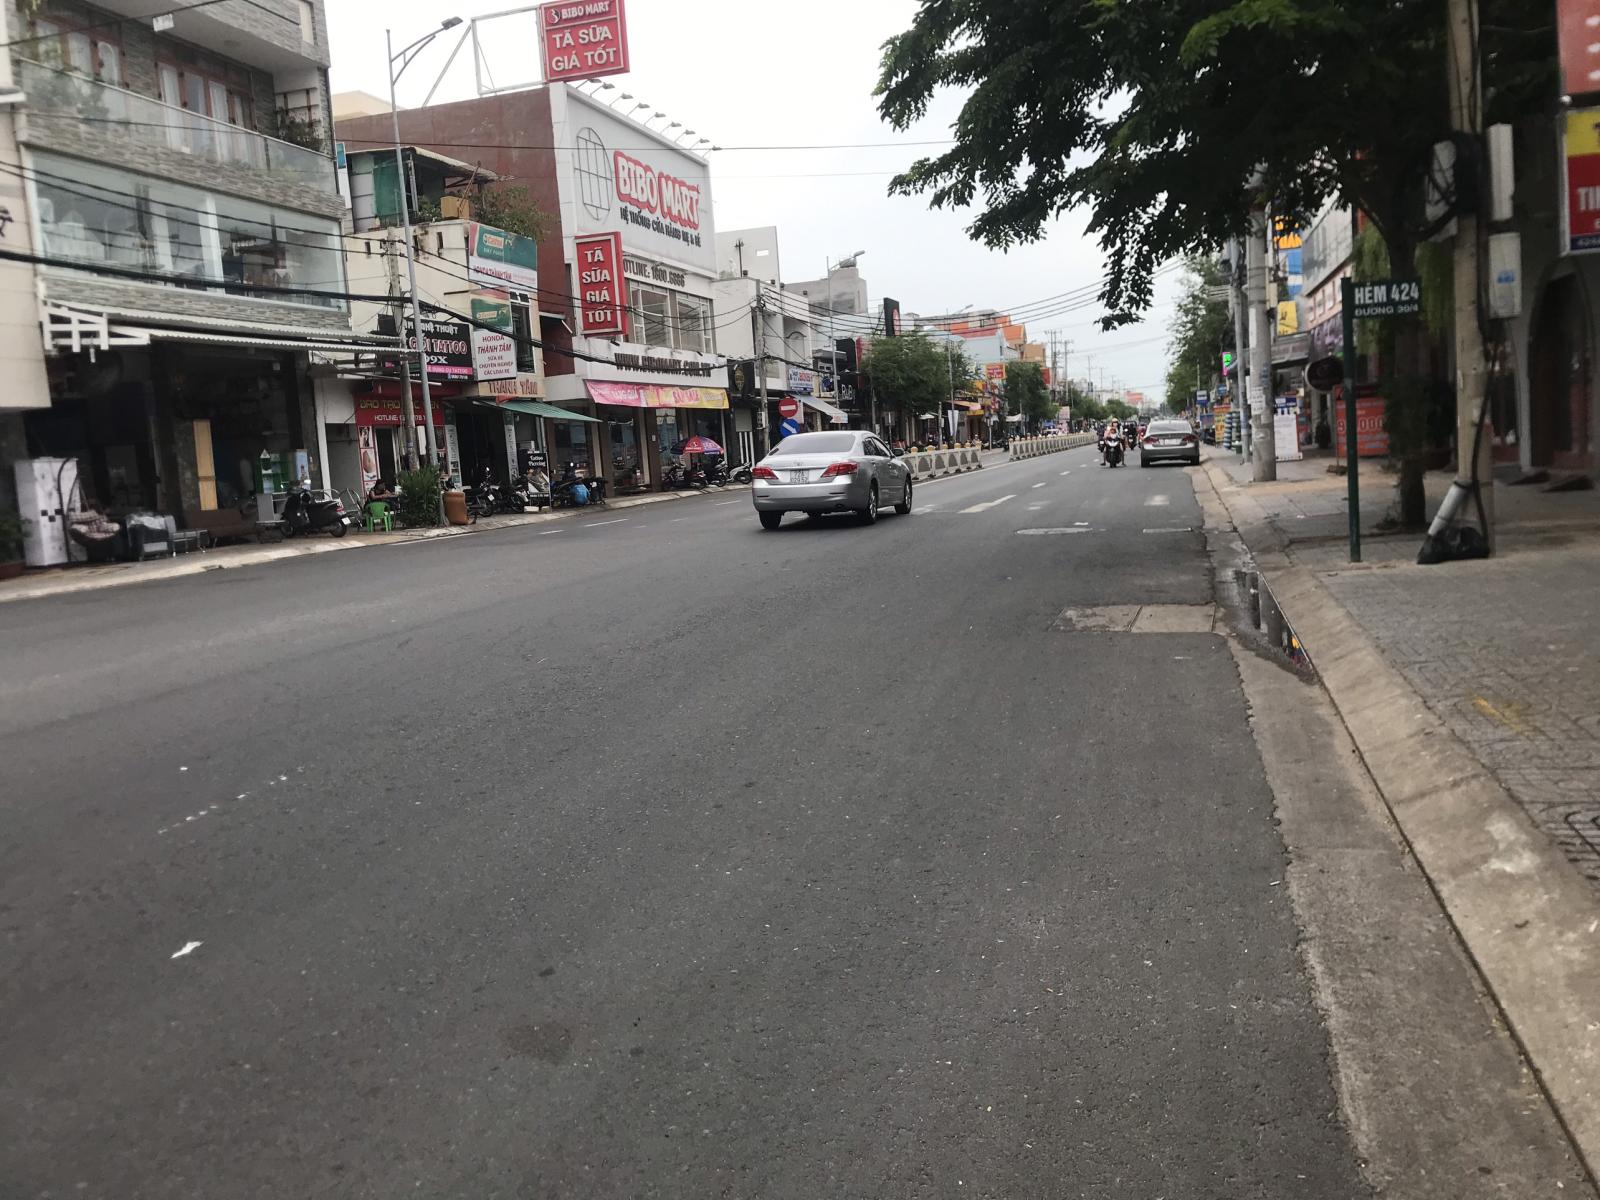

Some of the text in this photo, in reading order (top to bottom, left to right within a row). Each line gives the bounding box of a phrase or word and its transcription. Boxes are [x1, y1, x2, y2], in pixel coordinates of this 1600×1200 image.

[561, 1, 610, 19] BIBO MART
[552, 25, 613, 49] TÃ SỮA
[552, 44, 617, 71] GIÁ TỐT
[616, 155, 699, 226] BIBO MART
[620, 206, 629, 225] HỆ
[629, 210, 651, 230] THỐNG
[652, 217, 665, 235] CỬA
[665, 223, 681, 241] HÀNG
[584, 246, 605, 263] TÃ
[582, 267, 611, 284] SỮA
[623, 259, 650, 279] OTLINE:
[586, 286, 610, 303] GIÁ
[1391, 282, 1419, 301] 424
[586, 305, 614, 323] TỐT
[431, 338, 468, 355] TATTOO
[477, 343, 511, 354] THÀNH TÂM
